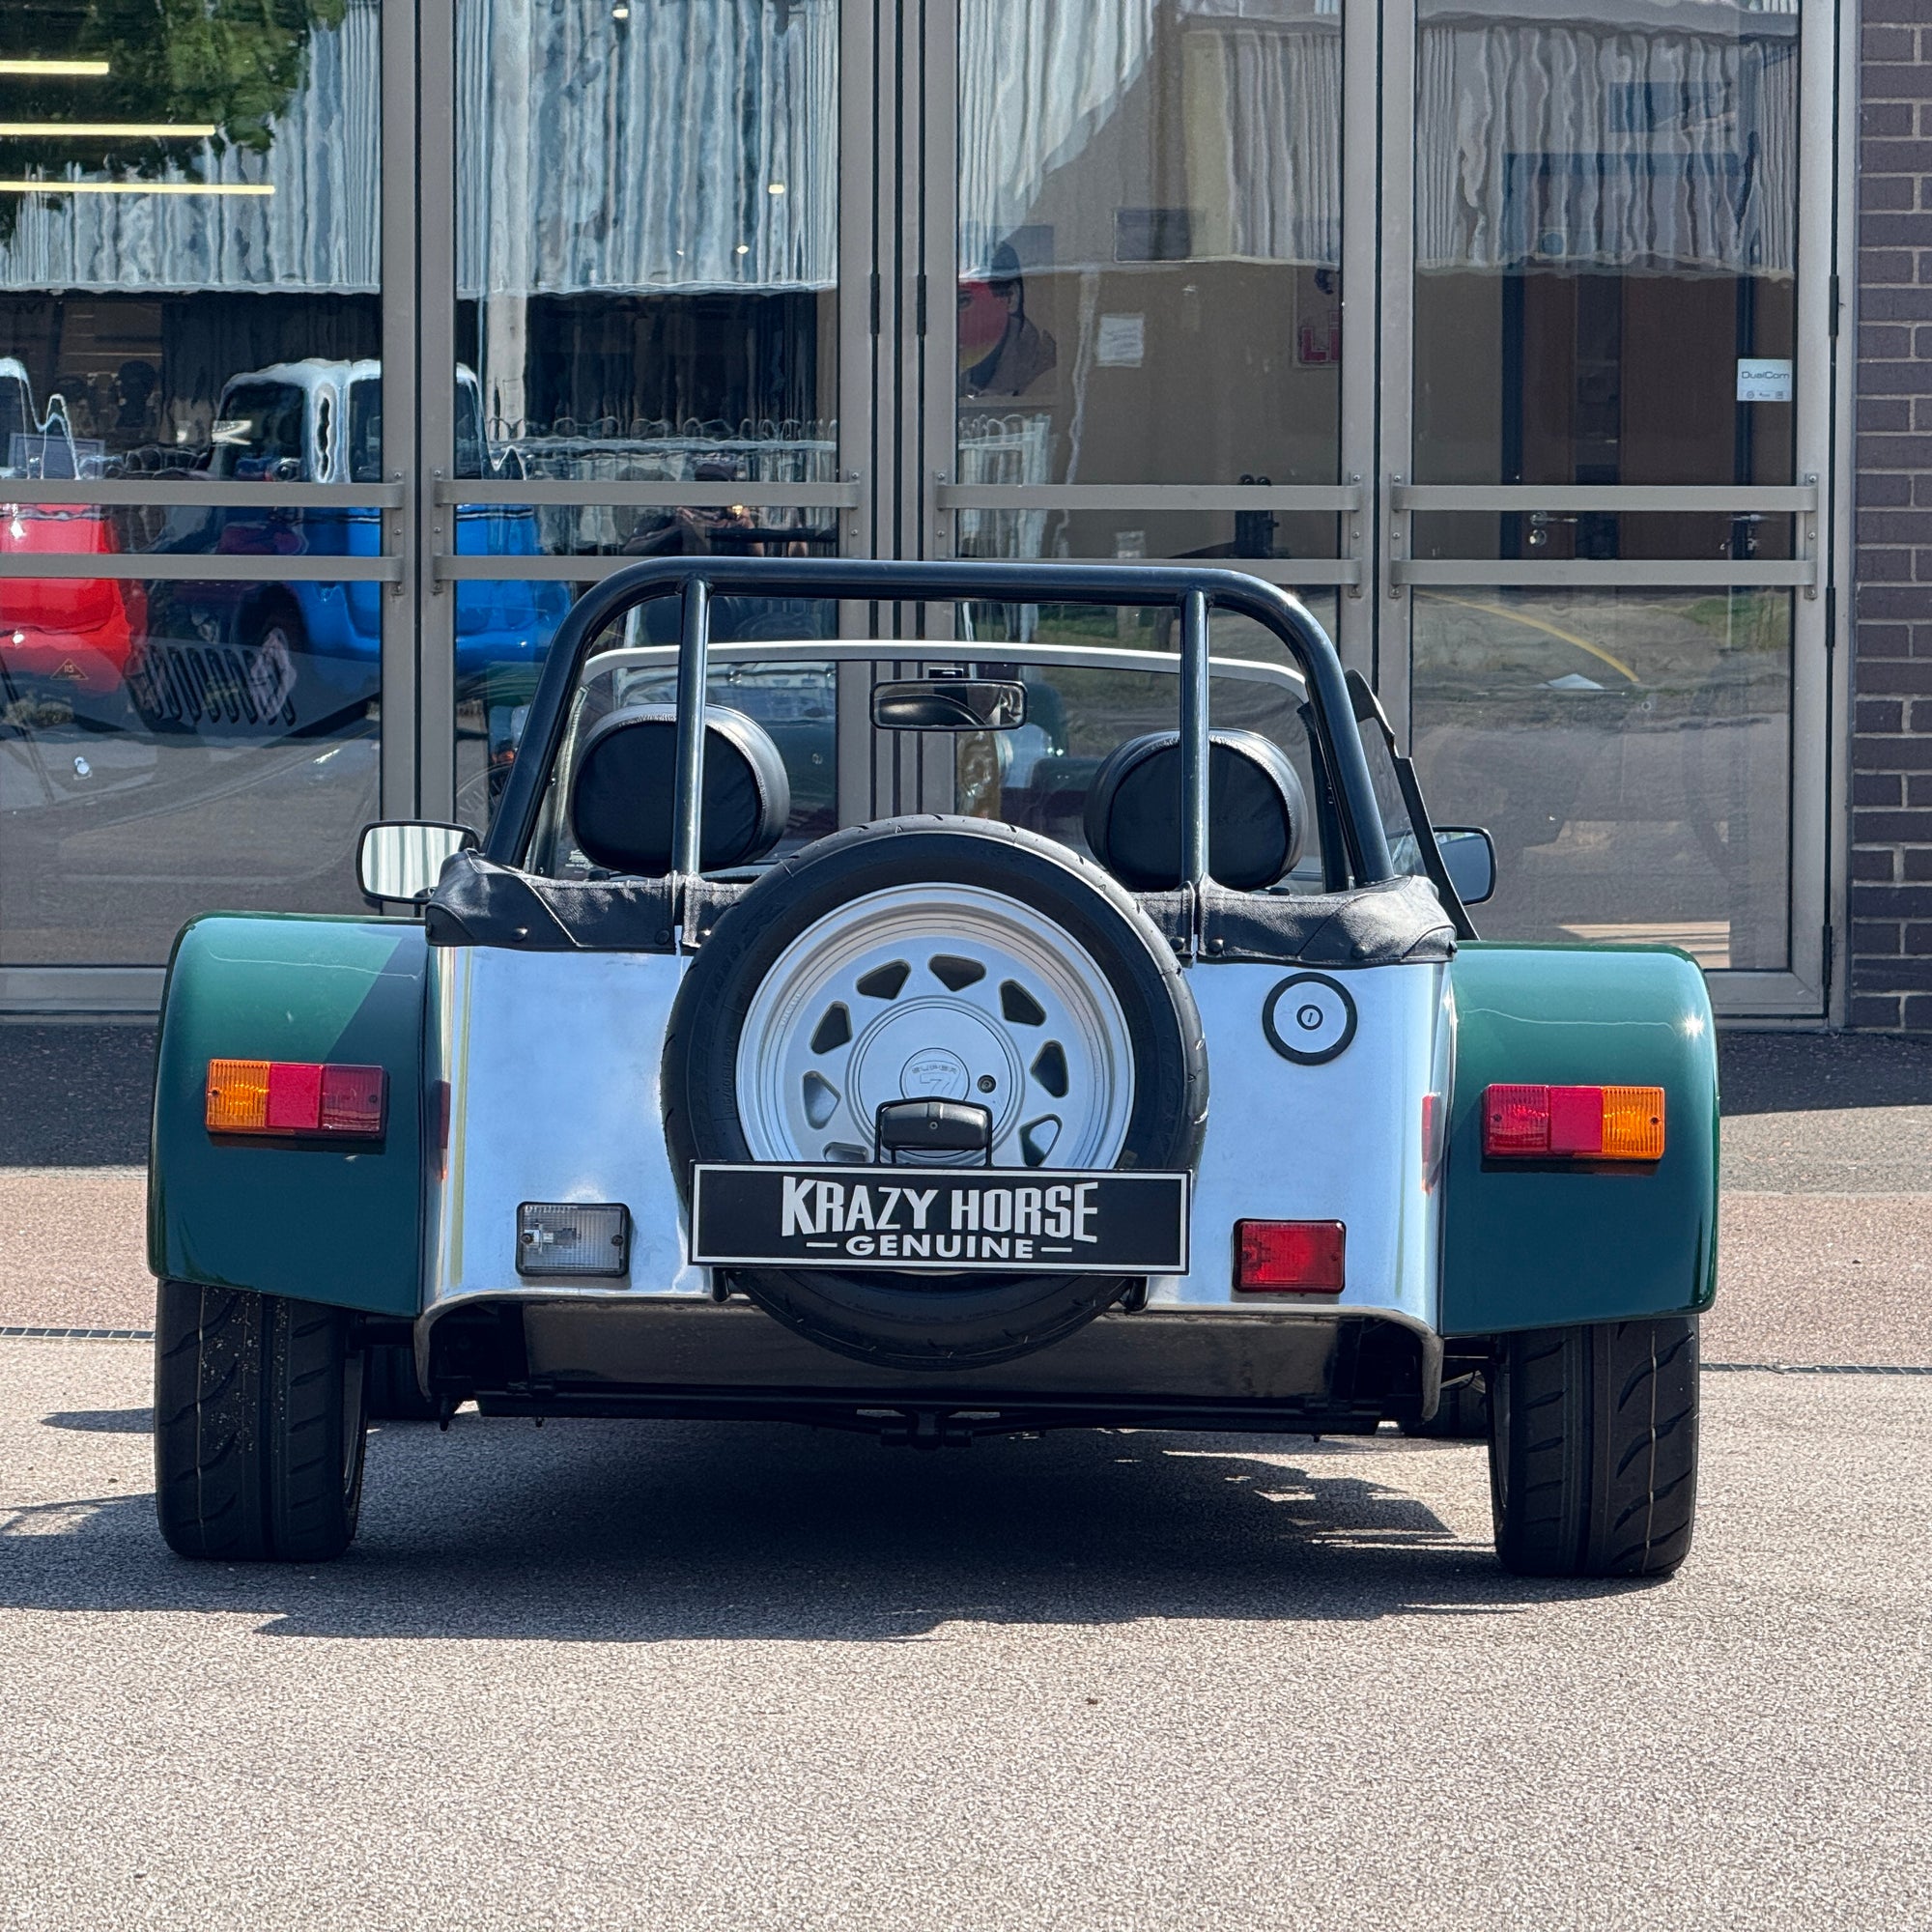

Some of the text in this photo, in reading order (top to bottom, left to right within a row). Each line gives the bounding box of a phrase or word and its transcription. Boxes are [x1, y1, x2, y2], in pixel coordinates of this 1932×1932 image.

[1741, 371, 1790, 380] DualCom
[911, 1064, 957, 1074] SUPER
[781, 1176, 1099, 1243] KRAZY HORSE
[845, 1235, 1034, 1259] GENUINE
